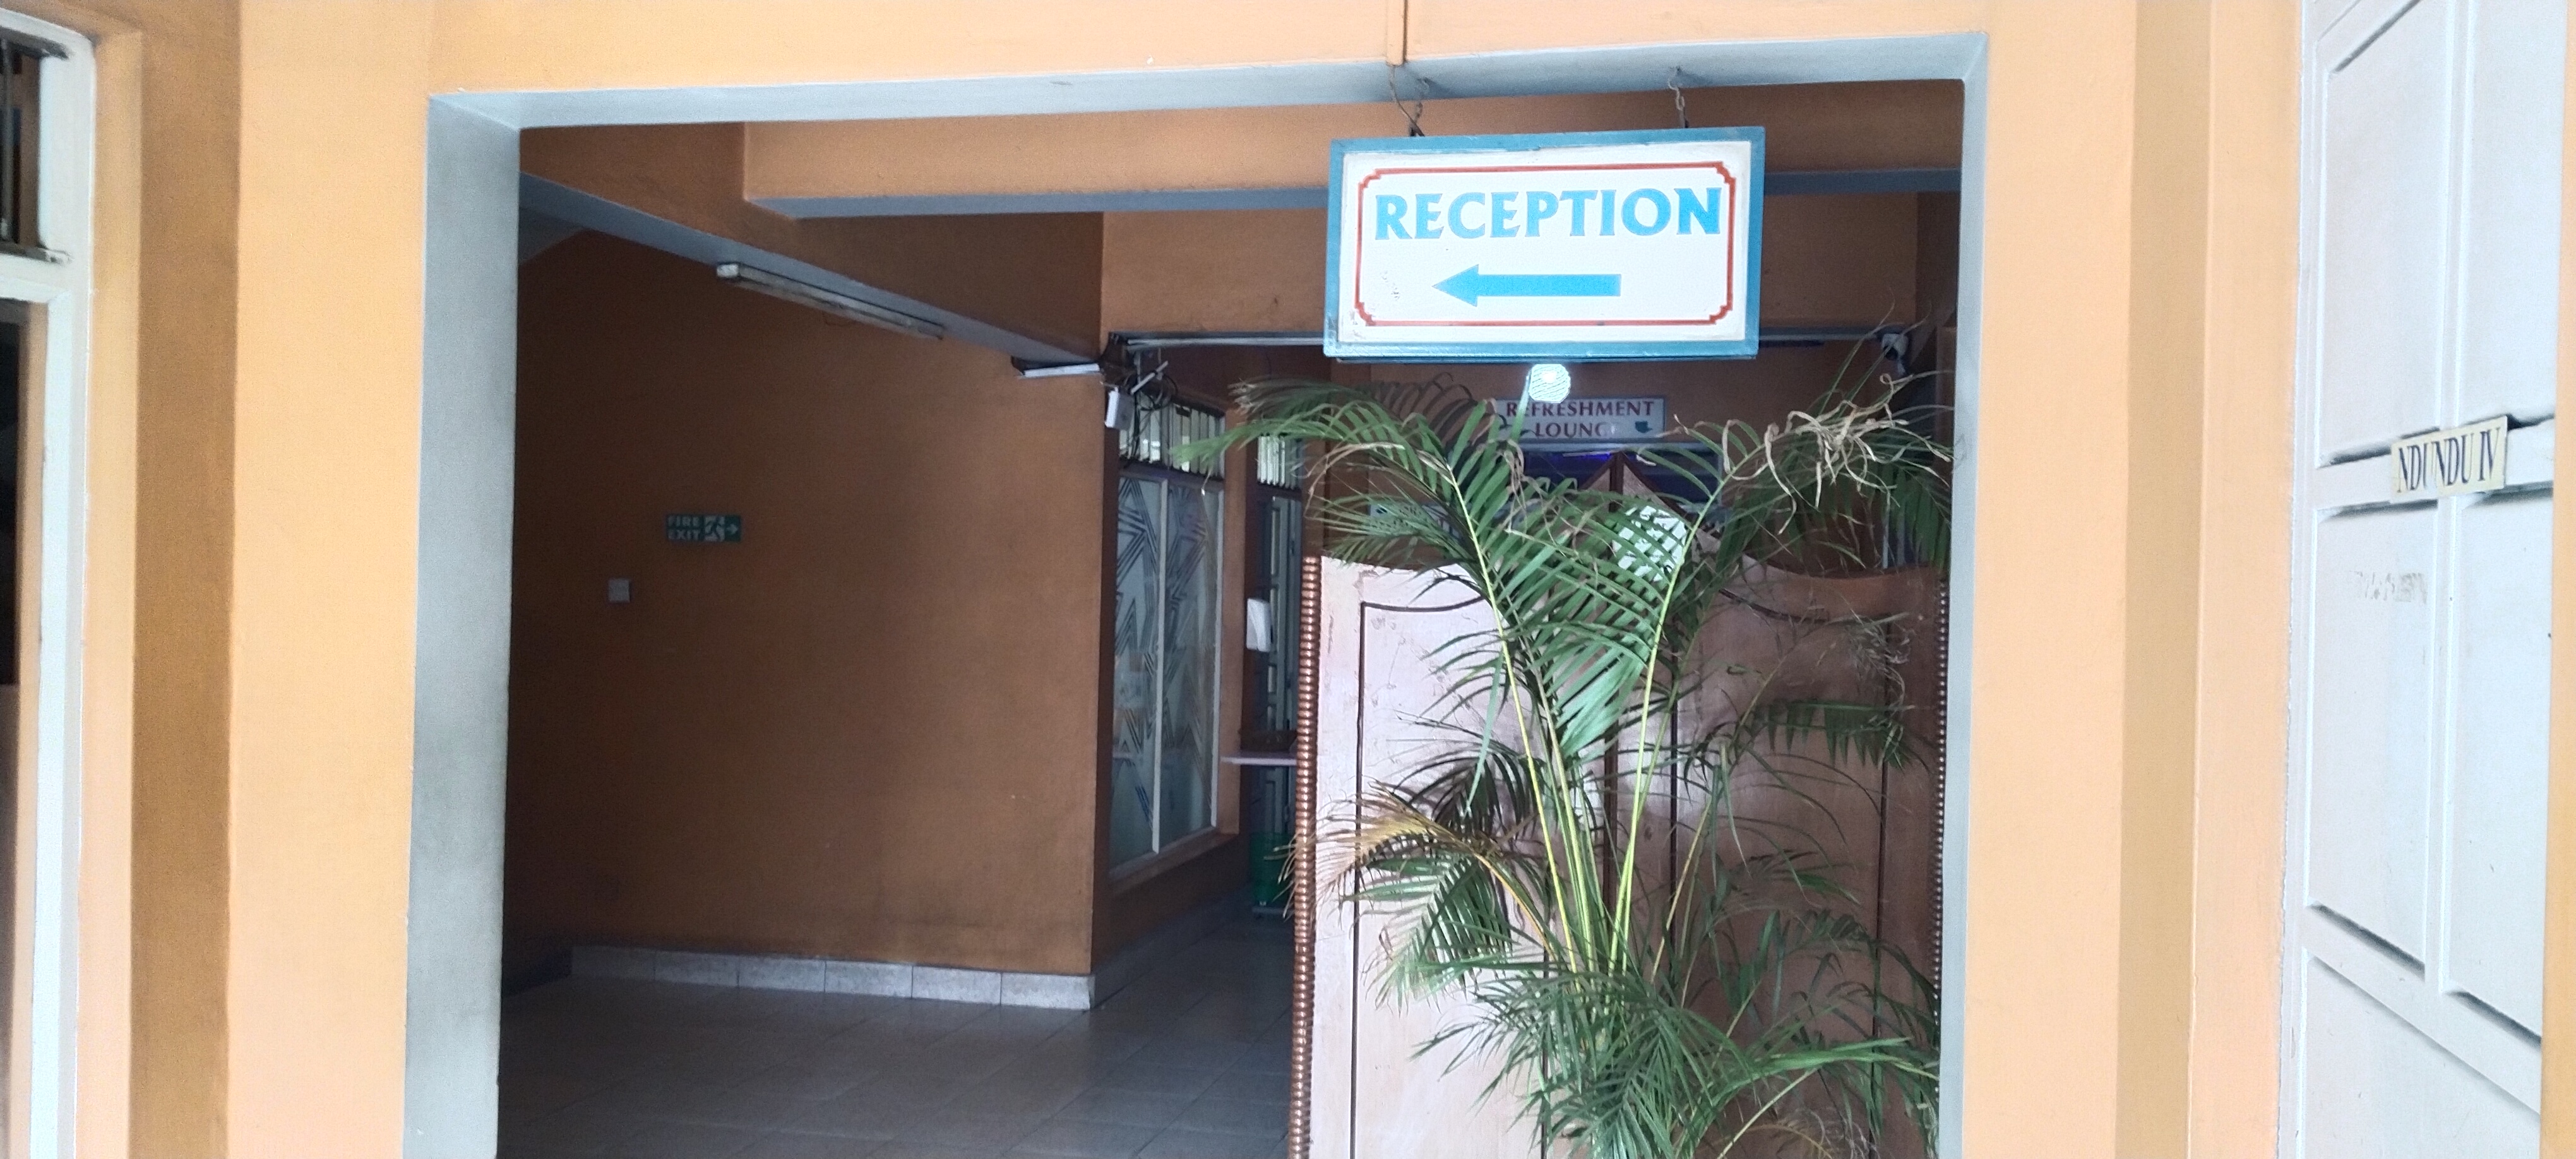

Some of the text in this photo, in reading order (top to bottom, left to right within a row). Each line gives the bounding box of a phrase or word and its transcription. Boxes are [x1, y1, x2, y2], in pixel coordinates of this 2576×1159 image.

[1374, 187, 1722, 240] RECEPTION
[1535, 422, 1615, 437] LOUNG
[2478, 427, 2500, 482] IV
[668, 516, 700, 526] FIRE
[668, 529, 701, 540] EXIT
